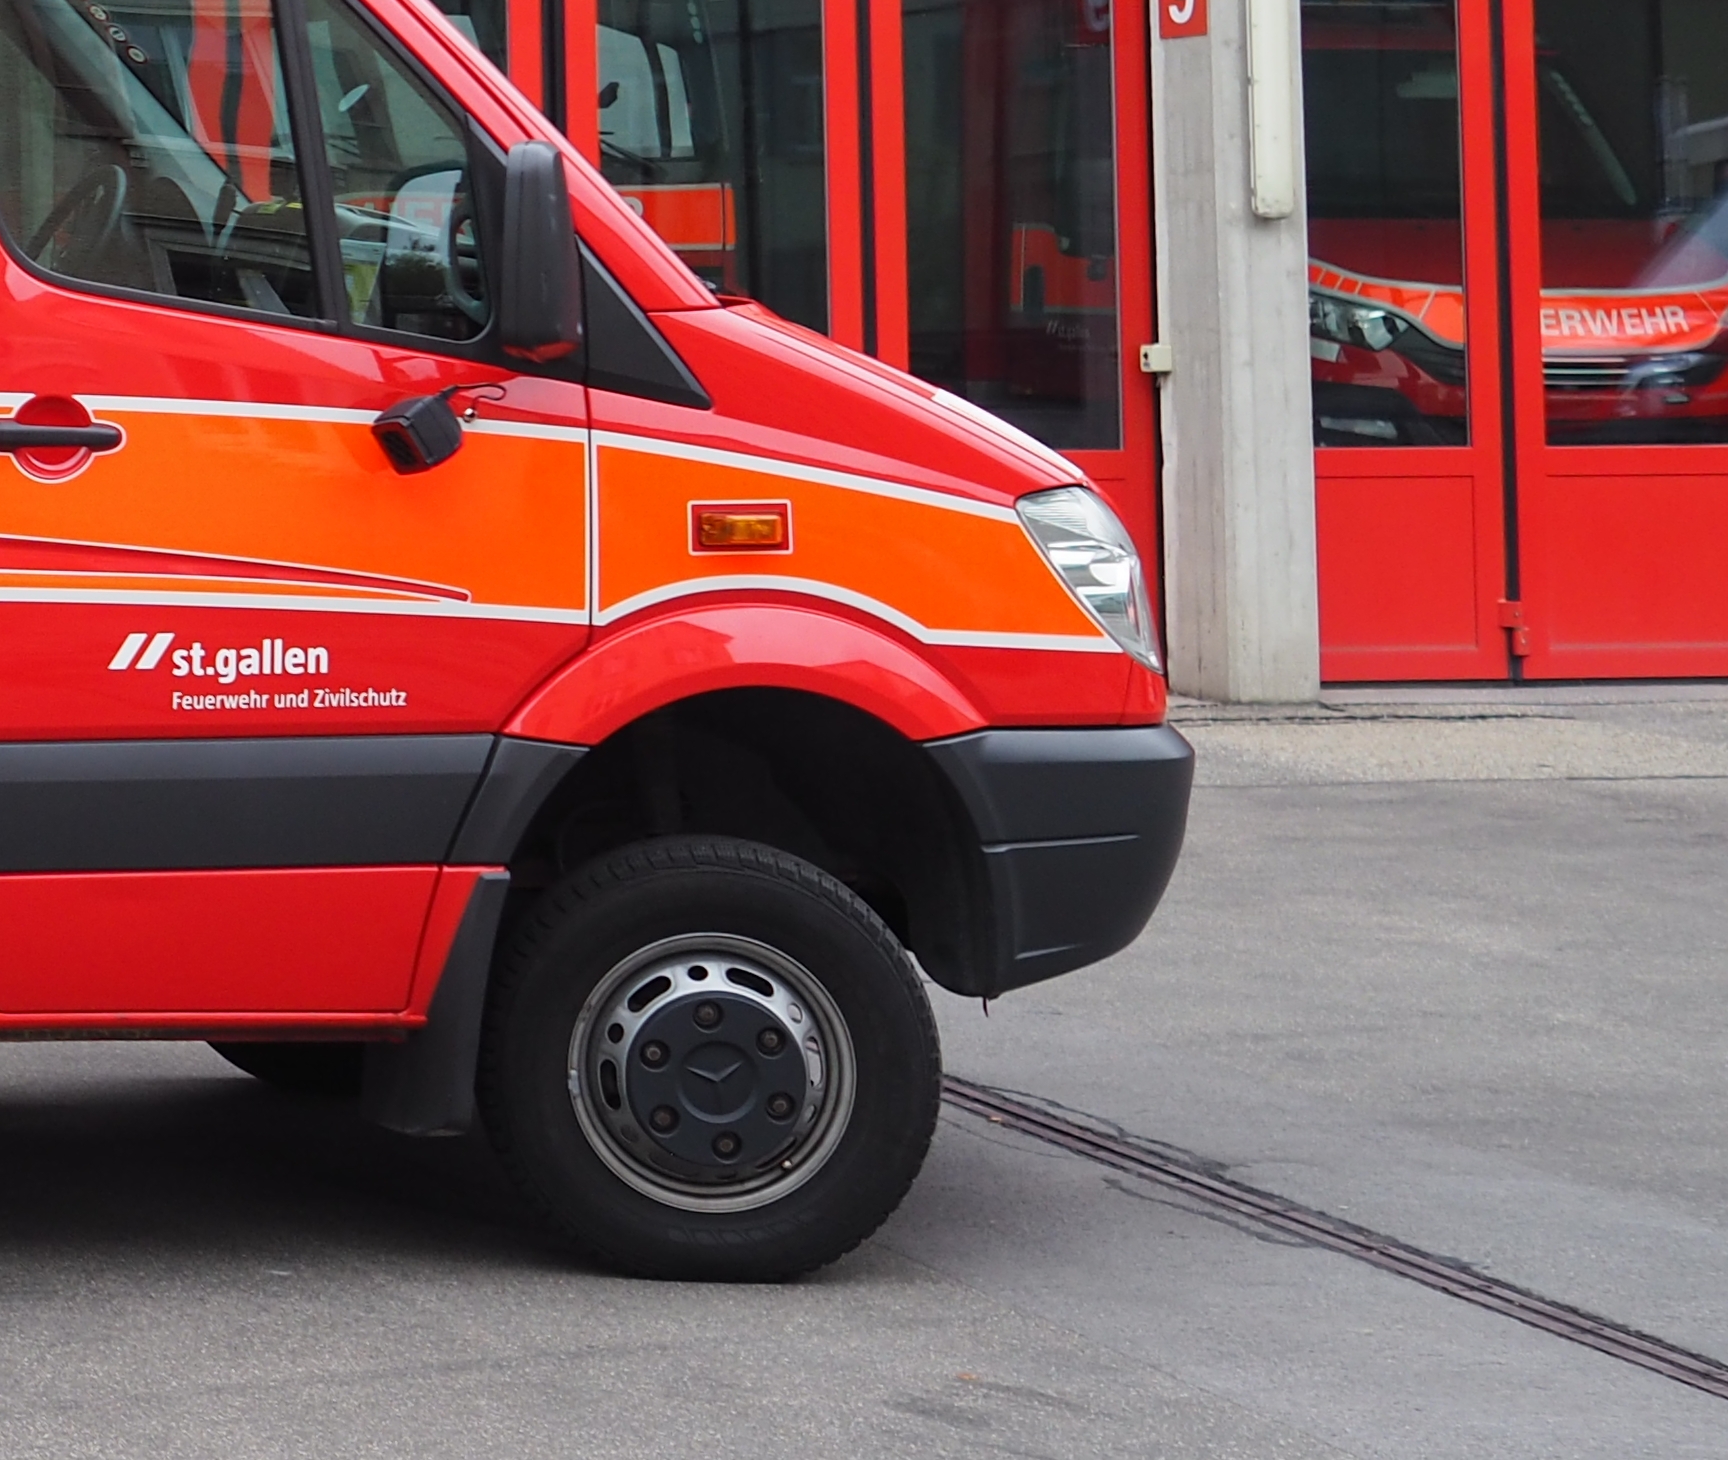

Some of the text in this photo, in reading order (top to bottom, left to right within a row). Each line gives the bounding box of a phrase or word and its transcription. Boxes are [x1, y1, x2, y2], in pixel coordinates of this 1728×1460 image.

[1540, 305, 1690, 337] ERWEHR
[171, 638, 329, 684] st.gallen
[172, 687, 407, 711] Feuerwehr und Zivilschutz
